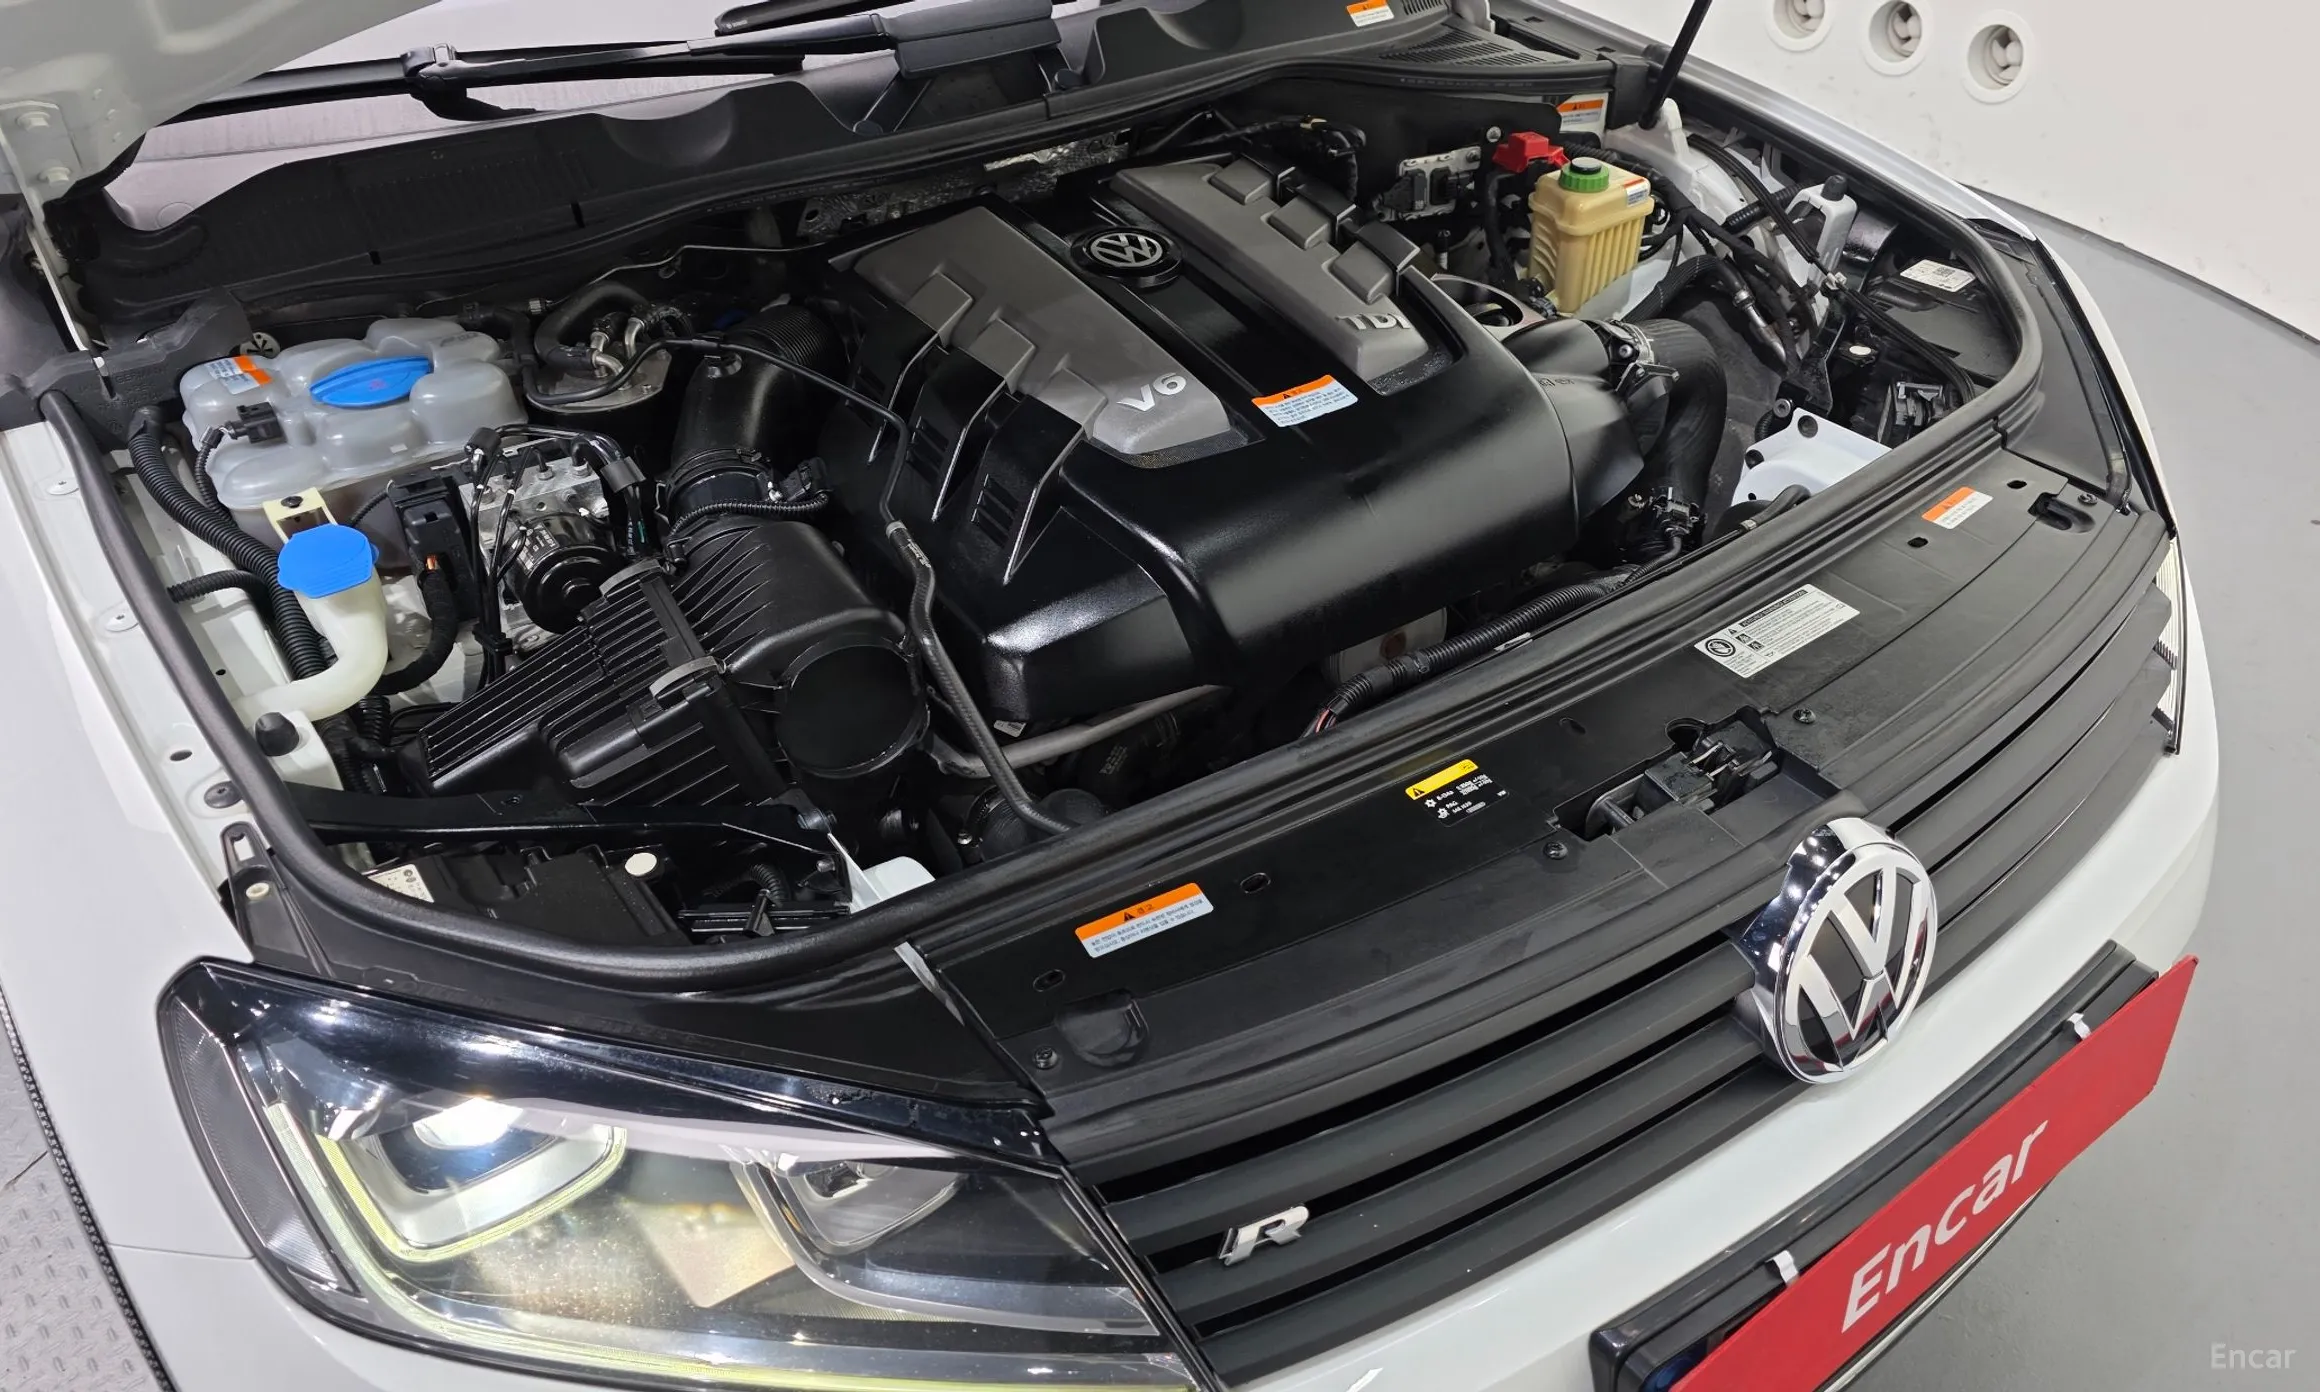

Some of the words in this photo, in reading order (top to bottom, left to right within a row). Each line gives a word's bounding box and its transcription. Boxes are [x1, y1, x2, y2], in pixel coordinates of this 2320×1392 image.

[1334, 312, 1411, 331] TDI
[1116, 372, 1187, 412] V6
[1219, 1205, 1309, 1266] R
[1841, 1119, 2049, 1334] Encar
